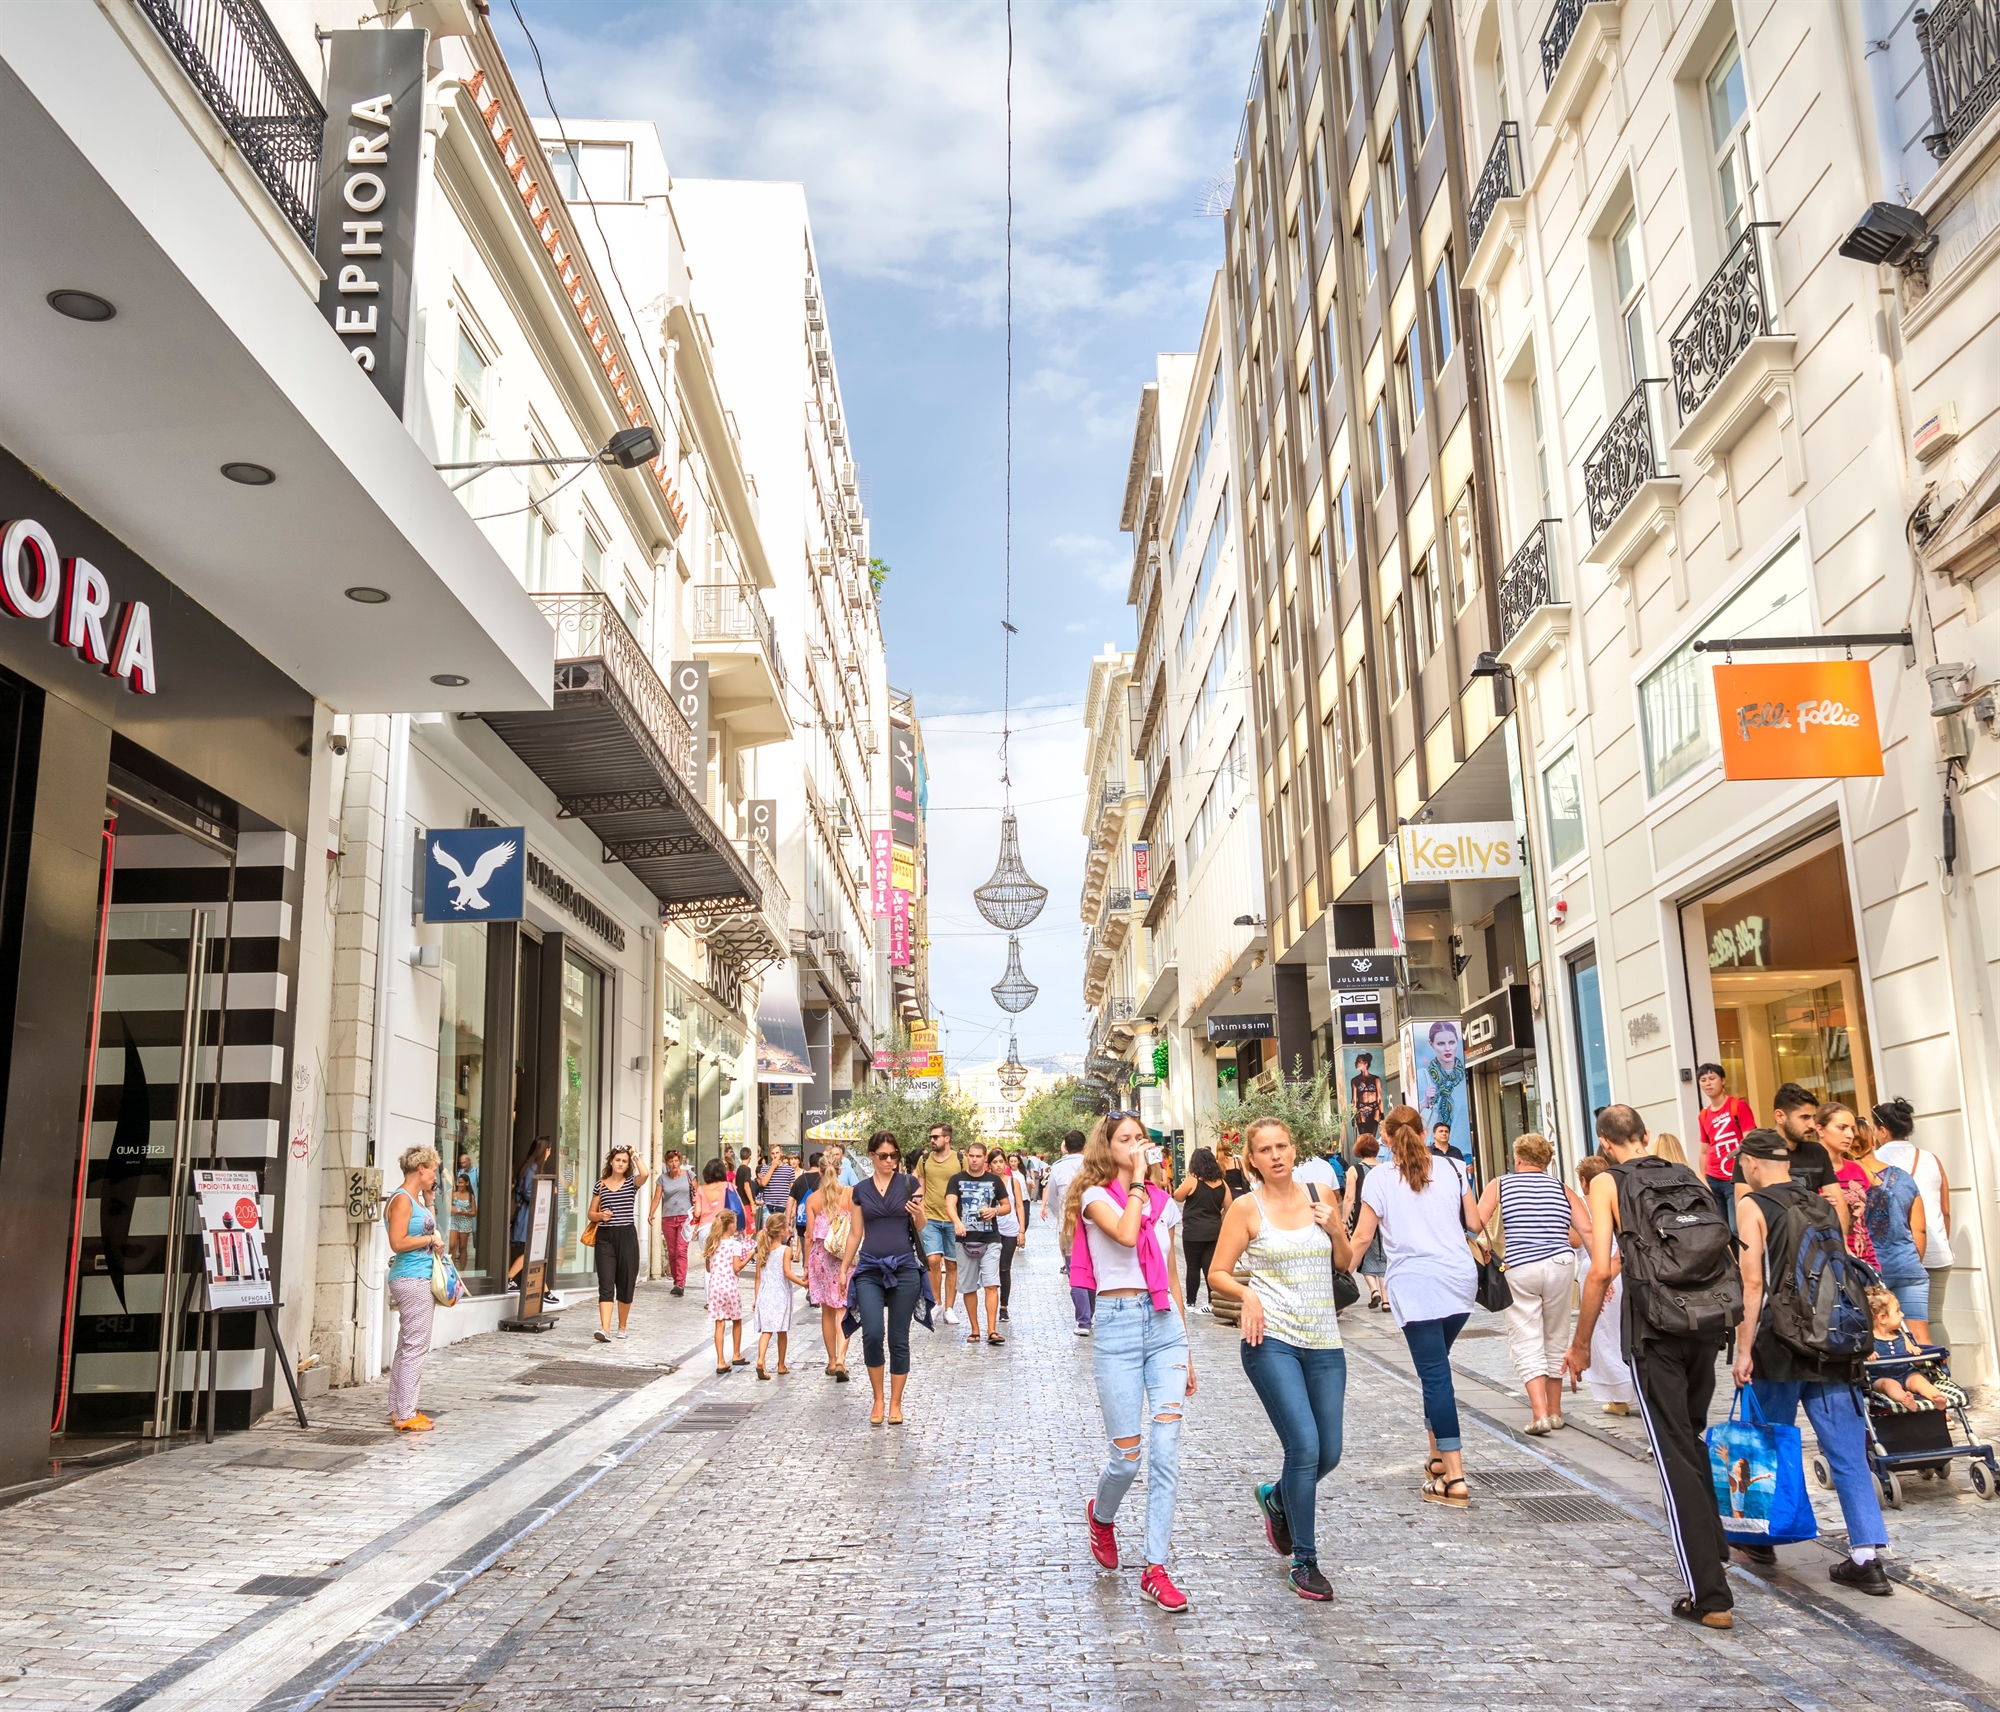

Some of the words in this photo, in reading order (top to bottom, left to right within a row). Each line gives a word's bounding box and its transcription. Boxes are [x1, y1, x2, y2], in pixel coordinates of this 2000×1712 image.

[2, 518, 156, 694] ORA
[1737, 701, 1792, 742] Folli
[1796, 699, 1860, 734] Follie
[1340, 994, 1379, 1003] MED
[1211, 1022, 1270, 1031] intimissimi
[235, 1205, 258, 1219] 20%
[240, 1295, 268, 1303] SEPHORA
